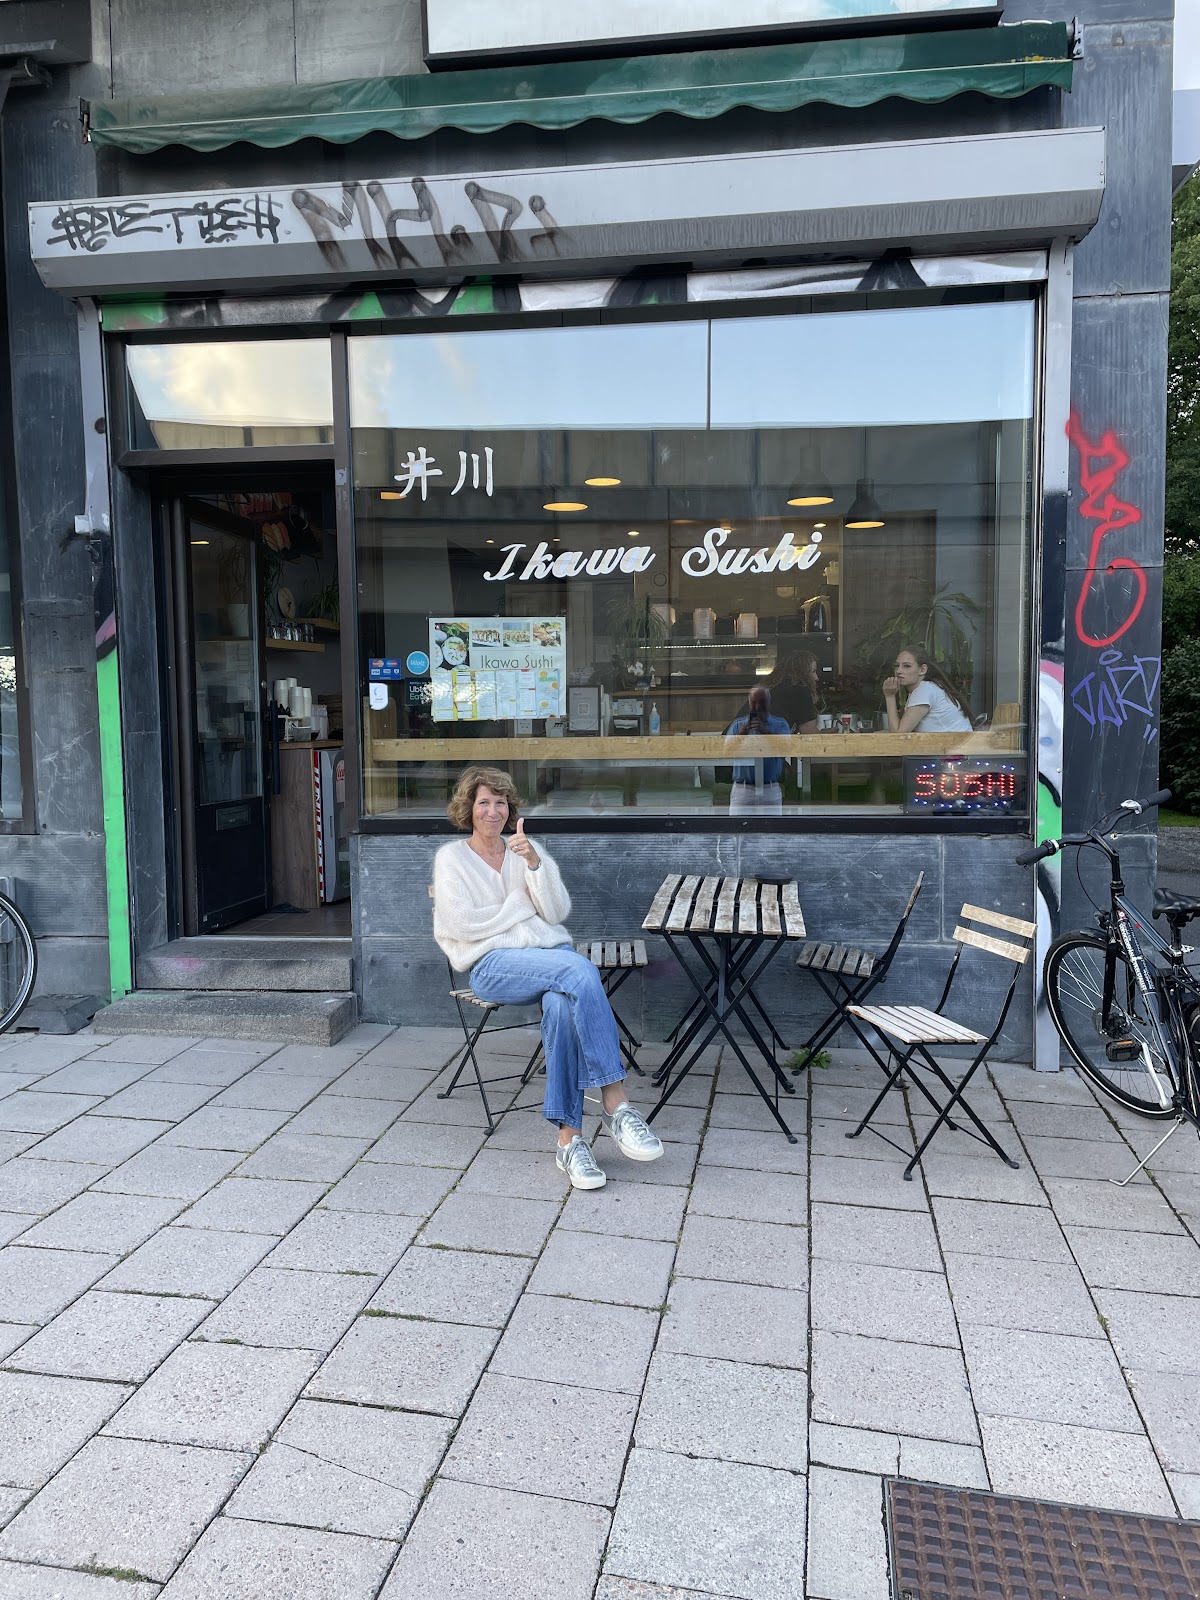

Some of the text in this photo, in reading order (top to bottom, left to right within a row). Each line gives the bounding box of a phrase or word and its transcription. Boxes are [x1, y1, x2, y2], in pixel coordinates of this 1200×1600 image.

[394, 446, 494, 500] 井川
[483, 527, 822, 581] Ikawa Sushi
[410, 658, 426, 667] Wolt
[481, 654, 553, 669] Ikawa Sushi
[915, 773, 1014, 797] SUSHI
